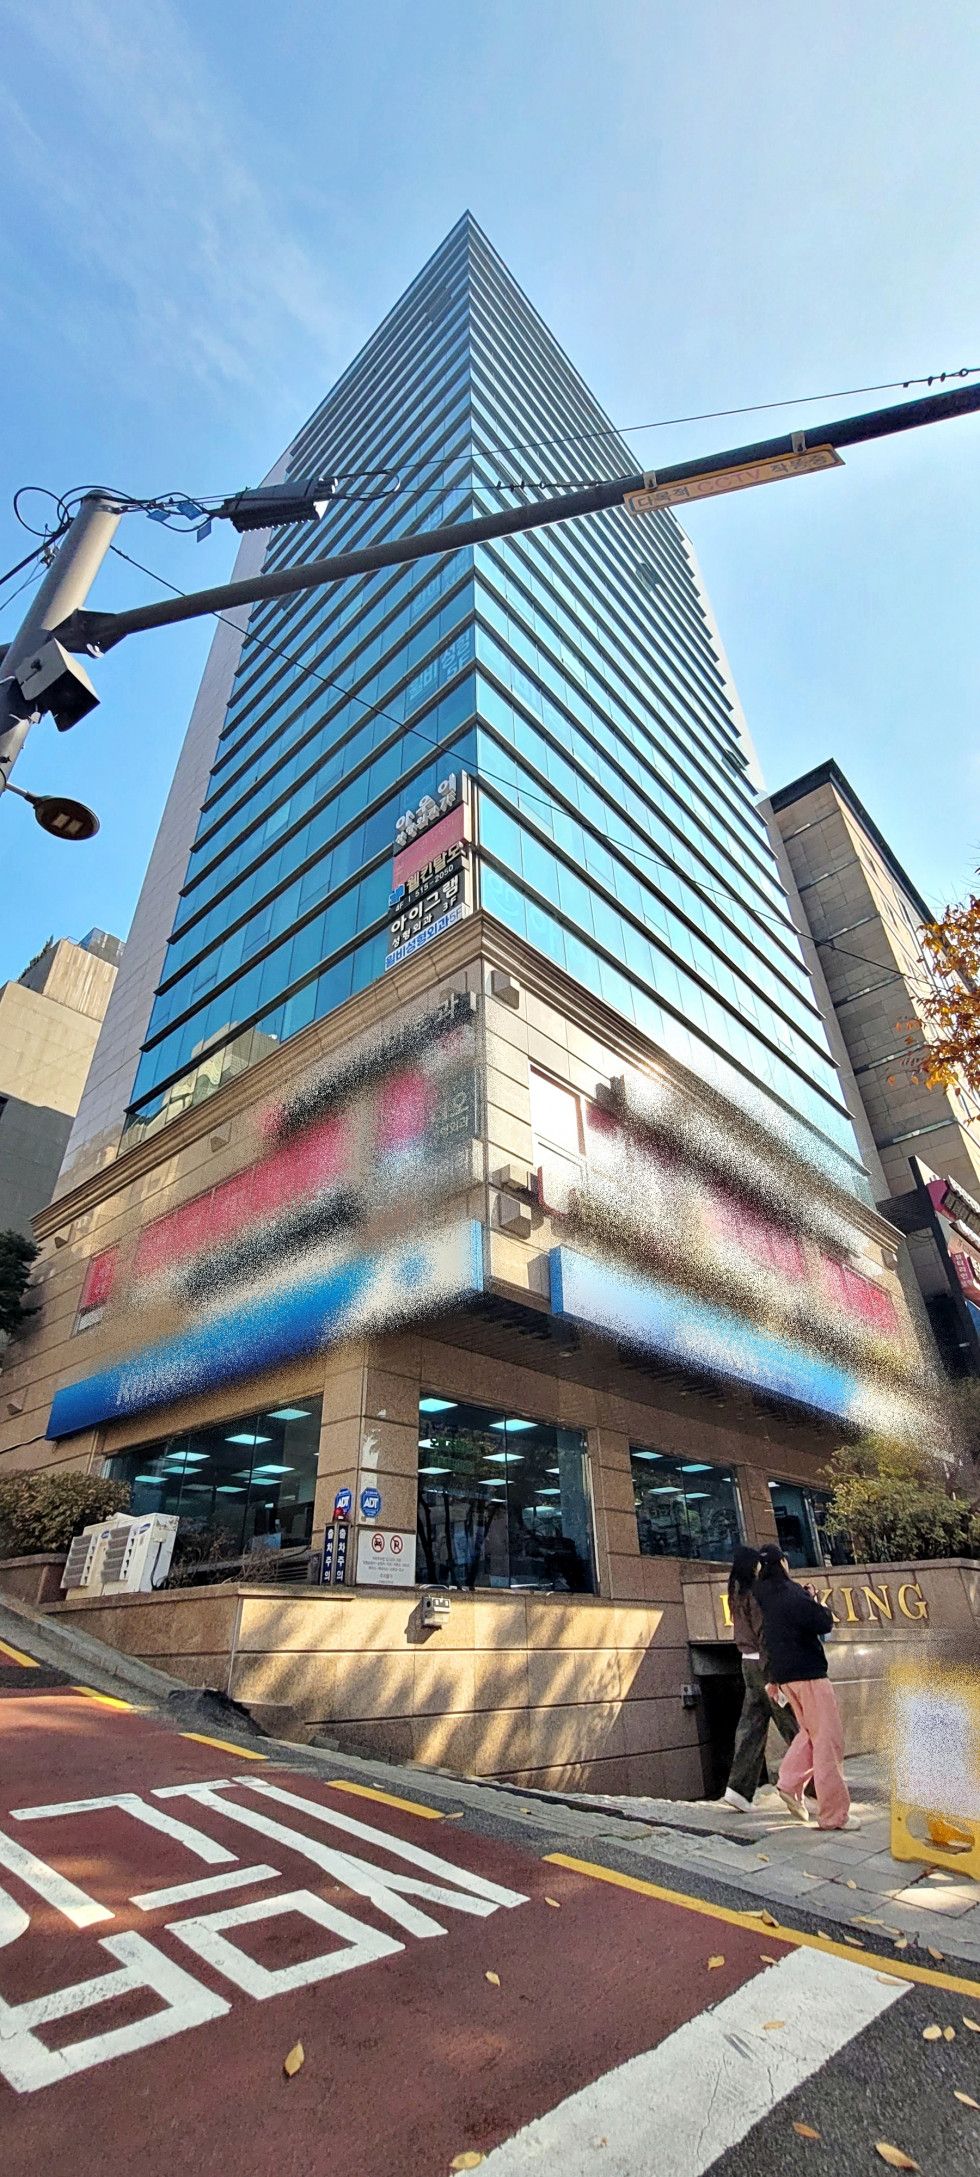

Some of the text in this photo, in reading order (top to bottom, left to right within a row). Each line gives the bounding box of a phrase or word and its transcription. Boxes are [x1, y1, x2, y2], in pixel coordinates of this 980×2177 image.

[697, 467, 762, 493] CCTV
[391, 874, 459, 933] 아이그램
[392, 895, 457, 948] 성형외과 3F
[337, 1495, 350, 1508] ADT
[363, 1496, 379, 1509] ADT
